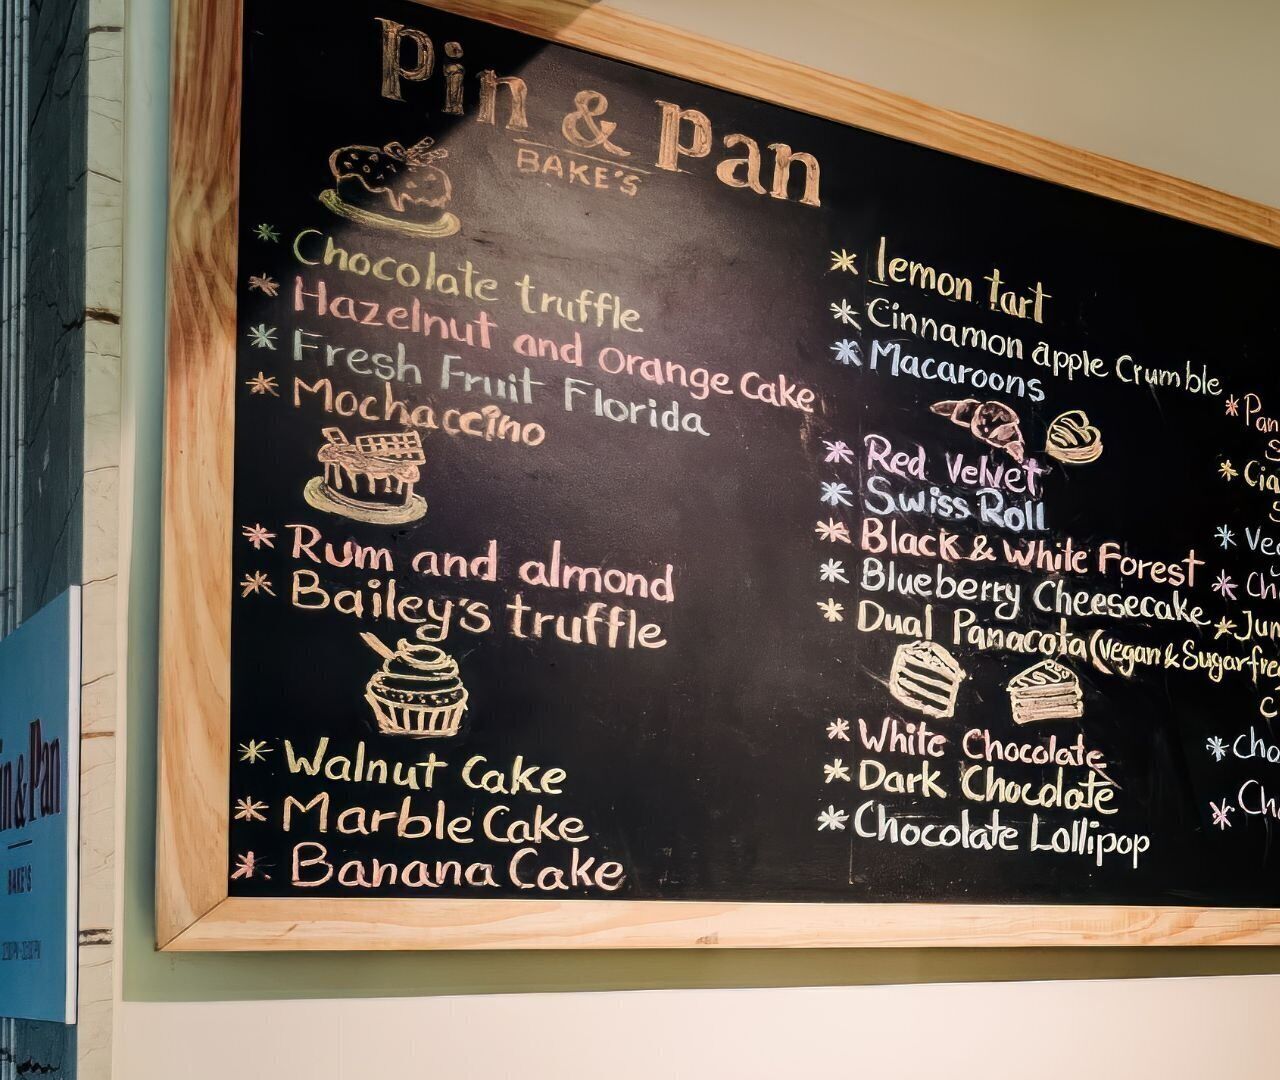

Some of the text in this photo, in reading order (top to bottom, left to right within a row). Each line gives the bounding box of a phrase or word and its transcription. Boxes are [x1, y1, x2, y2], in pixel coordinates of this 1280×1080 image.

[379, 17, 822, 207] Pin & Pan
[516, 149, 646, 196] BAKE'S
[294, 229, 644, 332] Chocolate truffle
[984, 269, 1051, 323] tart
[294, 276, 496, 348] Hazelnut
[513, 332, 583, 366] and
[741, 372, 815, 413] Cake
[867, 298, 1223, 396] Cinnamon apple Crumble
[870, 340, 1045, 401] Macaroons
[293, 329, 709, 436] Fresh Fruit Florida
[294, 376, 546, 446] Mochaccino
[864, 435, 1052, 495] Red Velvet
[864, 476, 1049, 531] Swiss Roll
[284, 524, 675, 602] Rum and almond
[862, 517, 1204, 587] Black & White Forest
[291, 570, 666, 649] Bailey's truffle
[857, 601, 932, 639] Dual
[861, 558, 1211, 626] Blueberry Cheesecake
[29, 718, 61, 822] Pan
[284, 737, 567, 795] Walnut Cake
[858, 718, 1107, 769] White Chocolate
[283, 792, 589, 843] Marble Cake
[859, 760, 1119, 814] Dark Chocolate
[291, 842, 626, 890] Banana Cake
[855, 802, 1150, 868] Chocolate Lollipop
